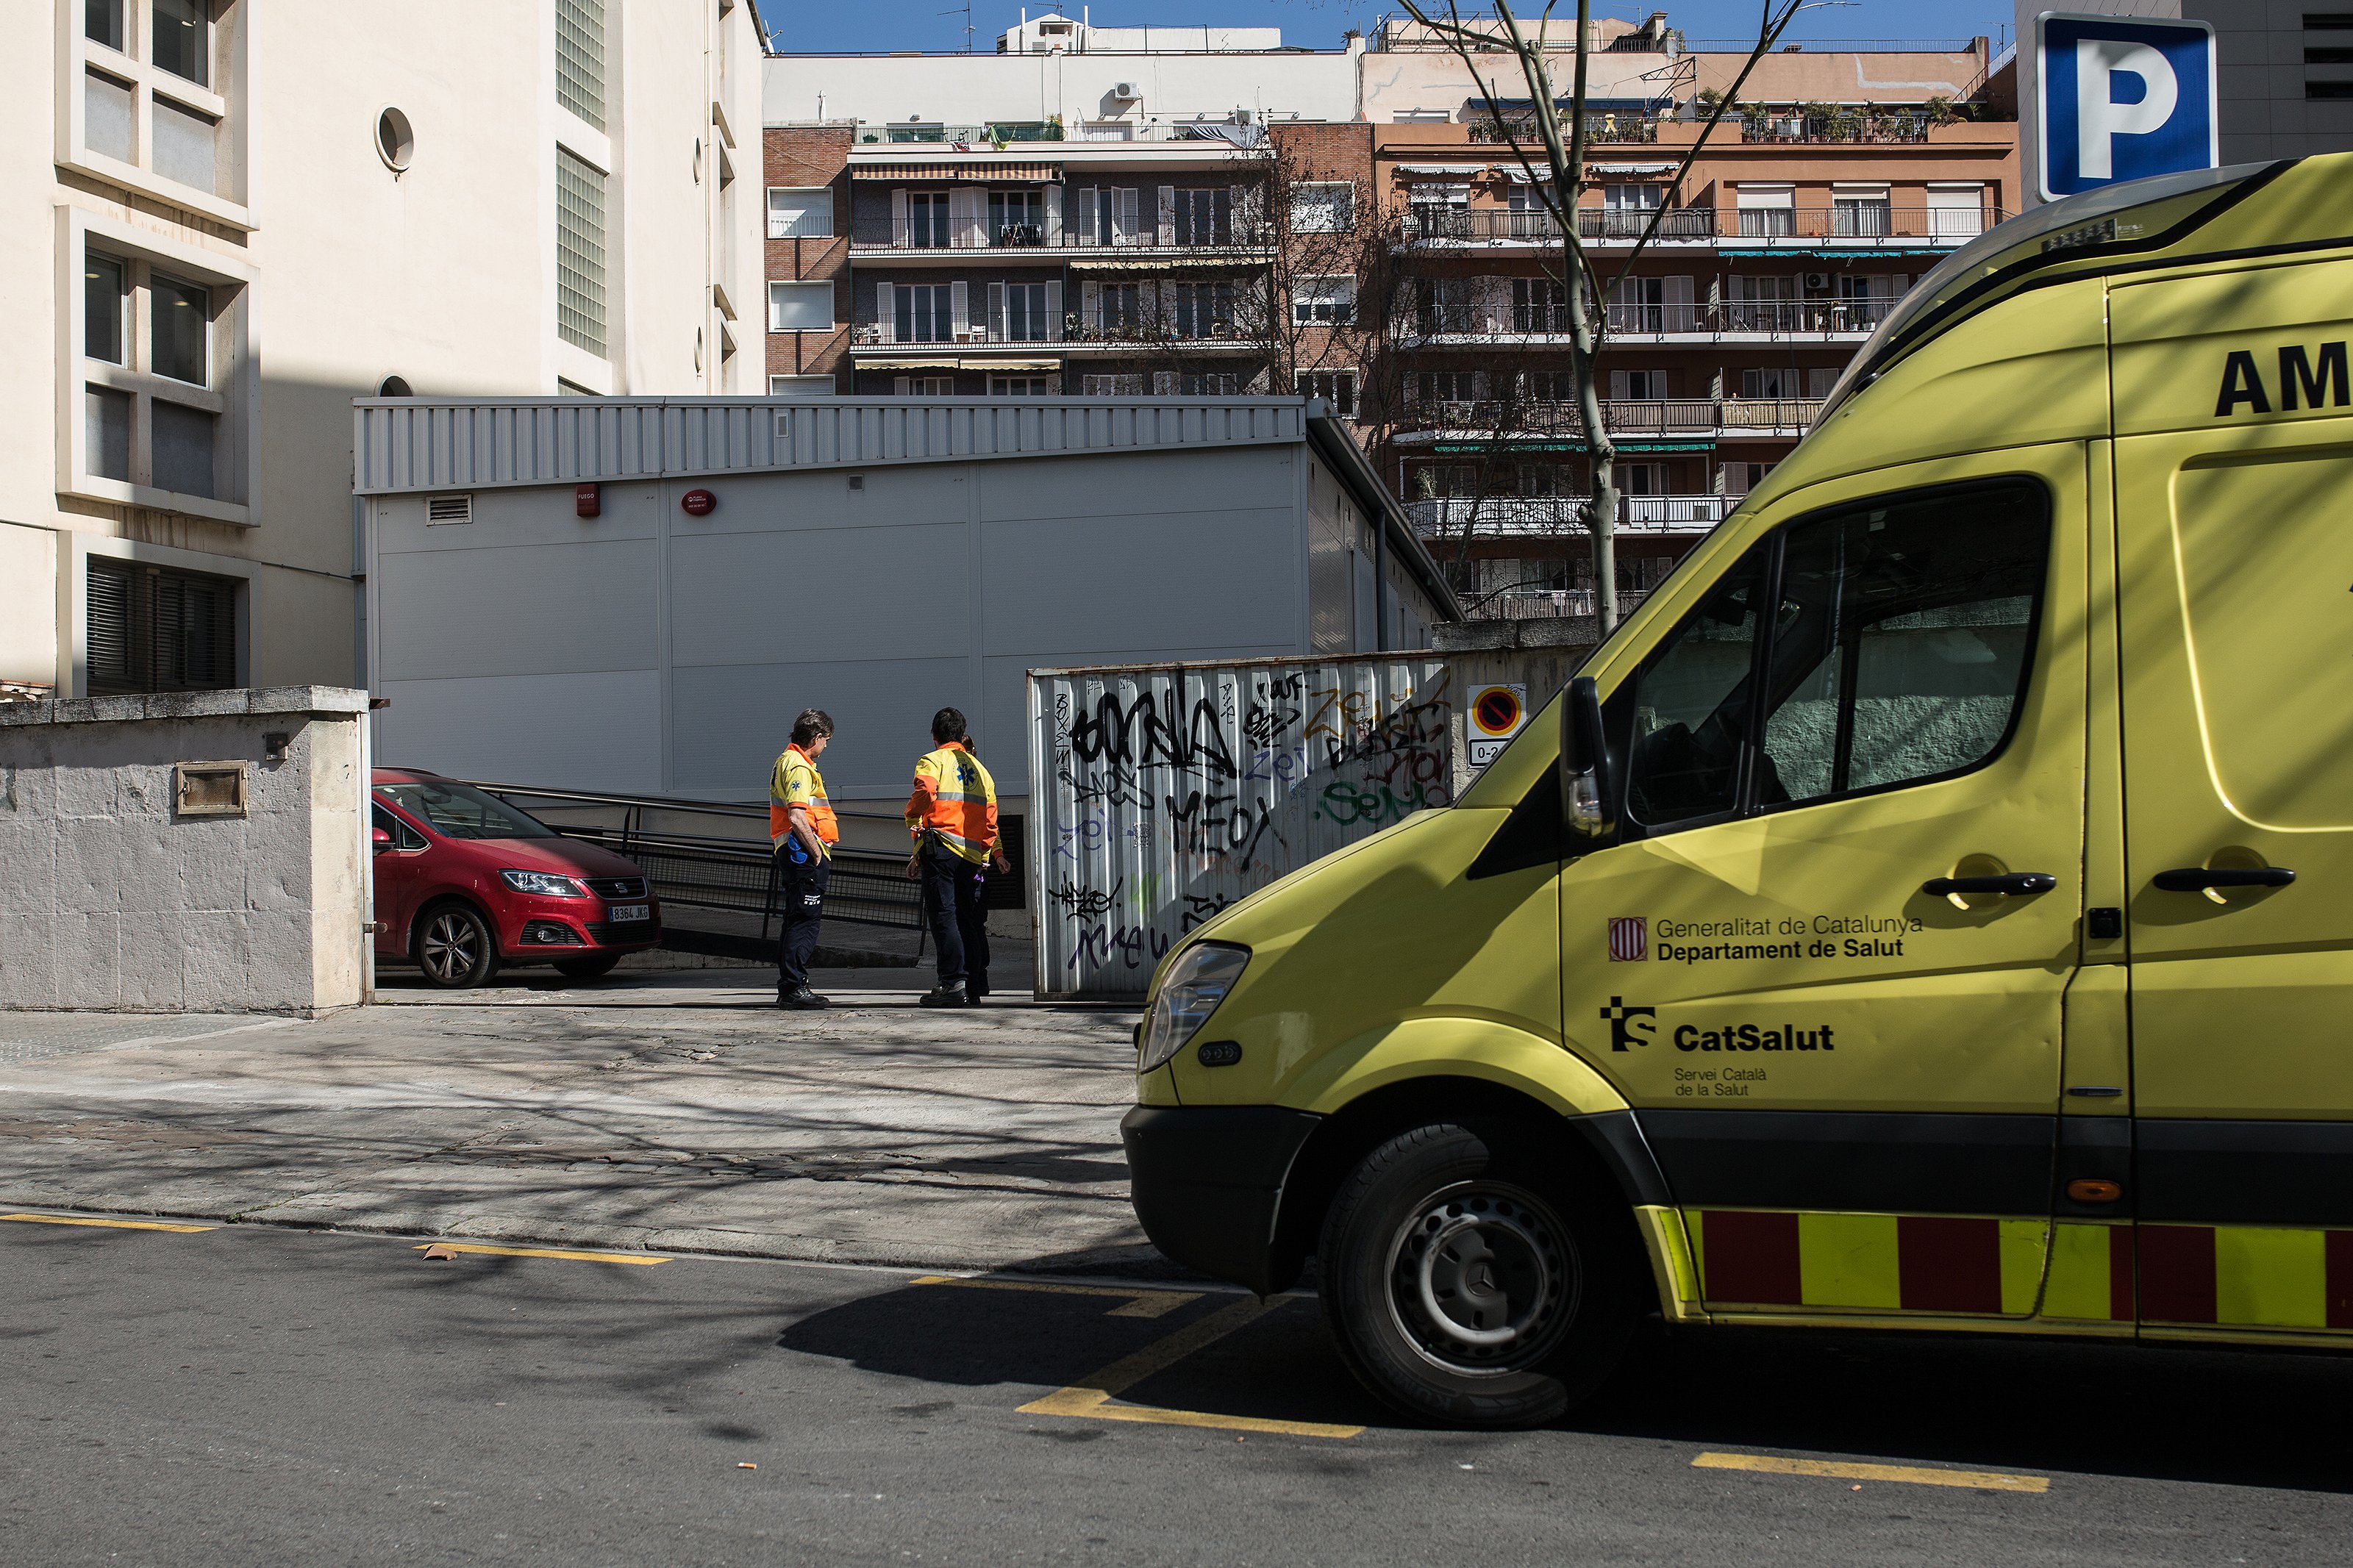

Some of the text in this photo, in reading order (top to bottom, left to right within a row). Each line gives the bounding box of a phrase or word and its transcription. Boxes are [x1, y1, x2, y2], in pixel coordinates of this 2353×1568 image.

[2077, 39, 2178, 179] P
[615, 906, 648, 920] 8364 JKG
[1657, 914, 1924, 938] Generalitat de Catalunya
[1657, 938, 1904, 964] Departament de Salut
[1674, 1024, 1835, 1051] CatSalut
[1674, 1067, 1767, 1081] Servei Català
[1675, 1083, 1749, 1096] de la Salut
